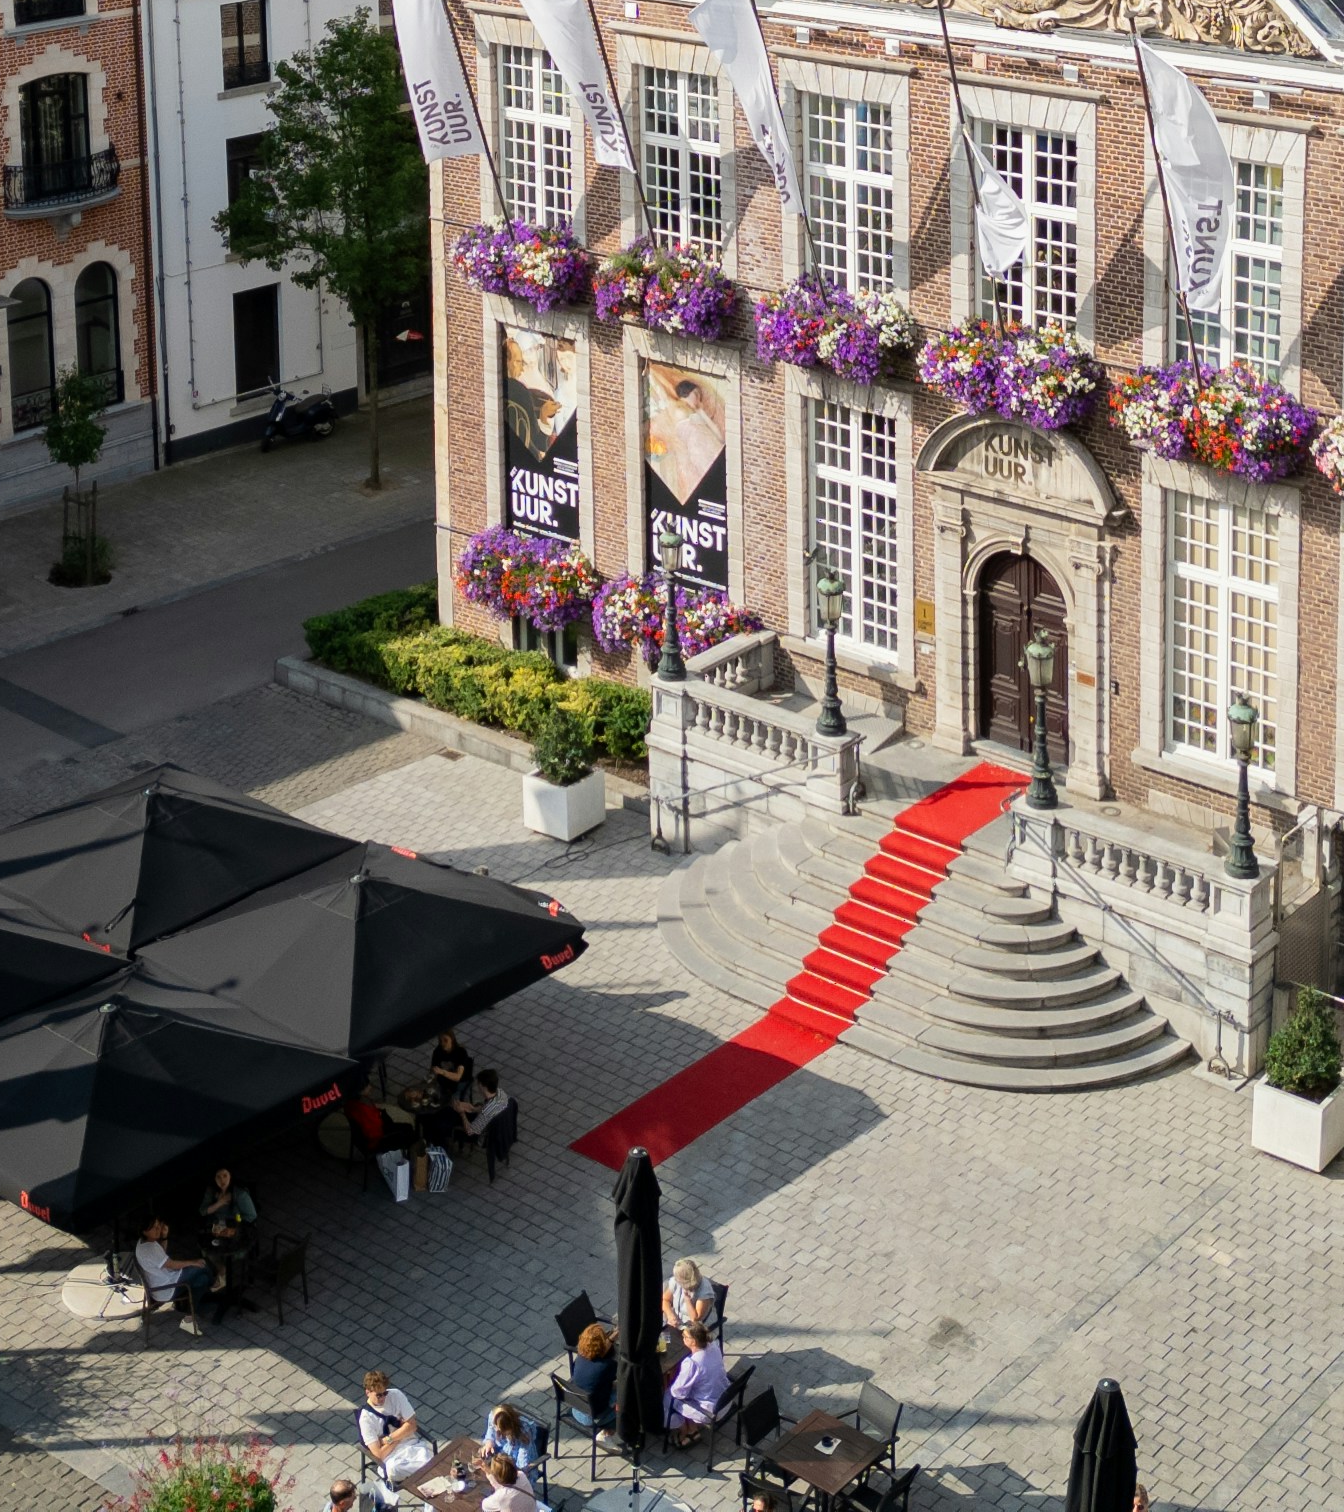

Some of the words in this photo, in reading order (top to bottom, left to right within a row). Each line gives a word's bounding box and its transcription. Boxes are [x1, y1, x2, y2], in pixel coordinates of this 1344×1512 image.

[412, 79, 451, 145] KUNST
[443, 93, 472, 144] UUR.
[578, 81, 618, 152] KUNST
[984, 431, 1057, 468] KUNST
[511, 468, 579, 508] KUNST
[984, 454, 1033, 486] UUR.
[512, 492, 559, 528] UUR.
[539, 944, 575, 971] Duvel
[302, 1082, 342, 1114] Duvel
